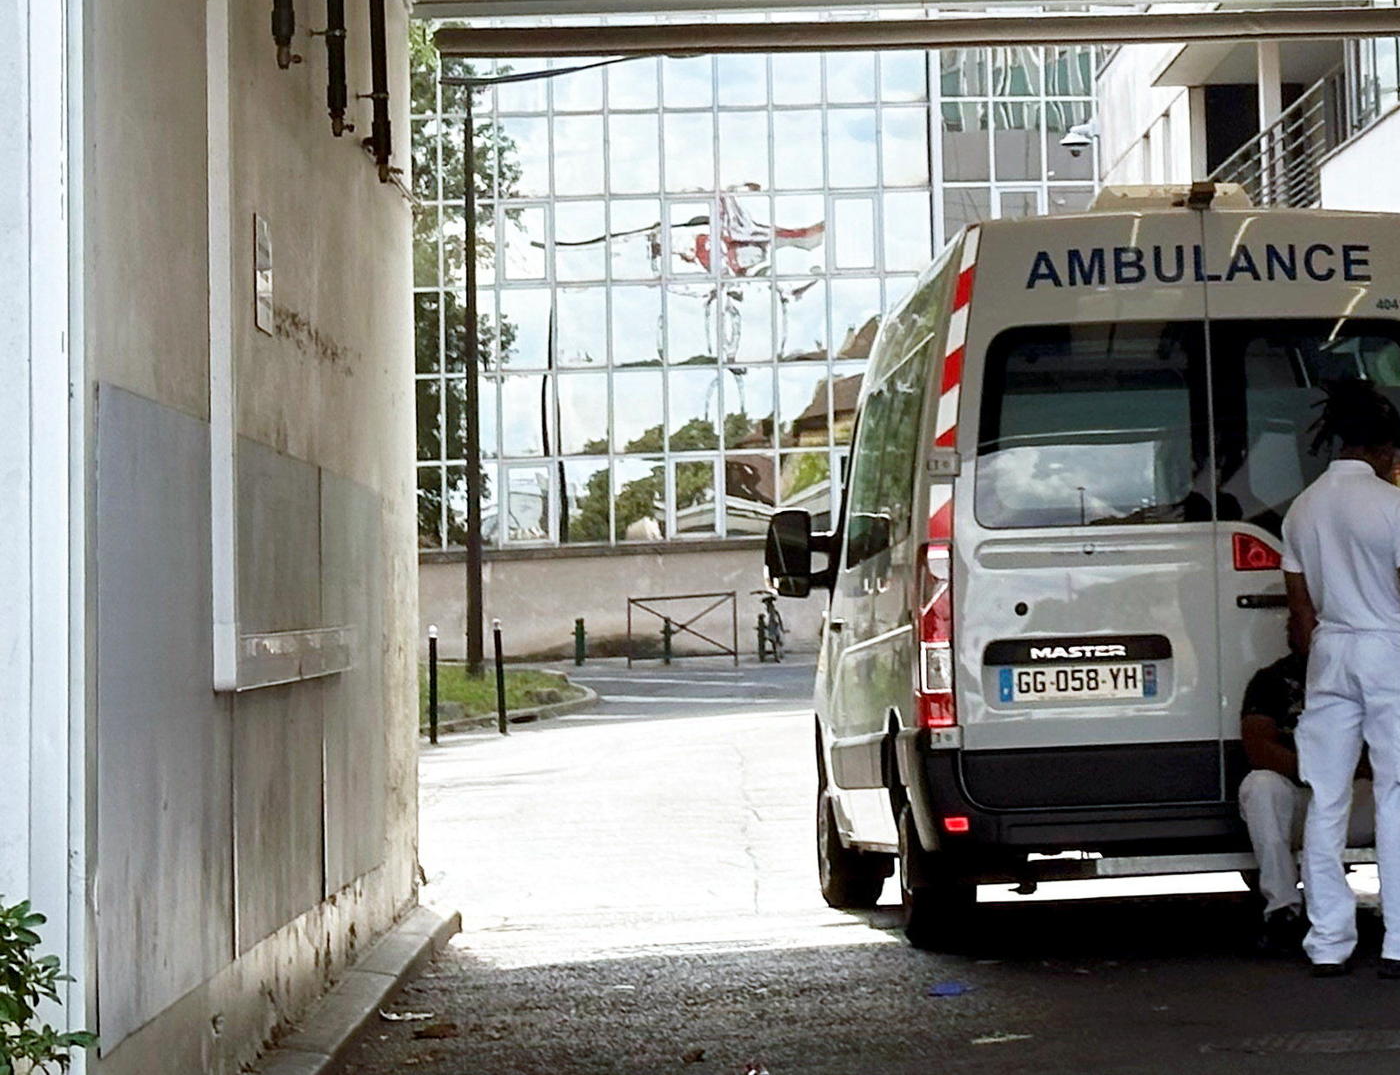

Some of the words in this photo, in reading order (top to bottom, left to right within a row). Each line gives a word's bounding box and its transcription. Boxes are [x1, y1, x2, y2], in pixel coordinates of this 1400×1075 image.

[1025, 243, 1373, 290] AMBULANCE
[1029, 644, 1127, 660] MASTER
[1017, 667, 1138, 694] GG-058-YH
